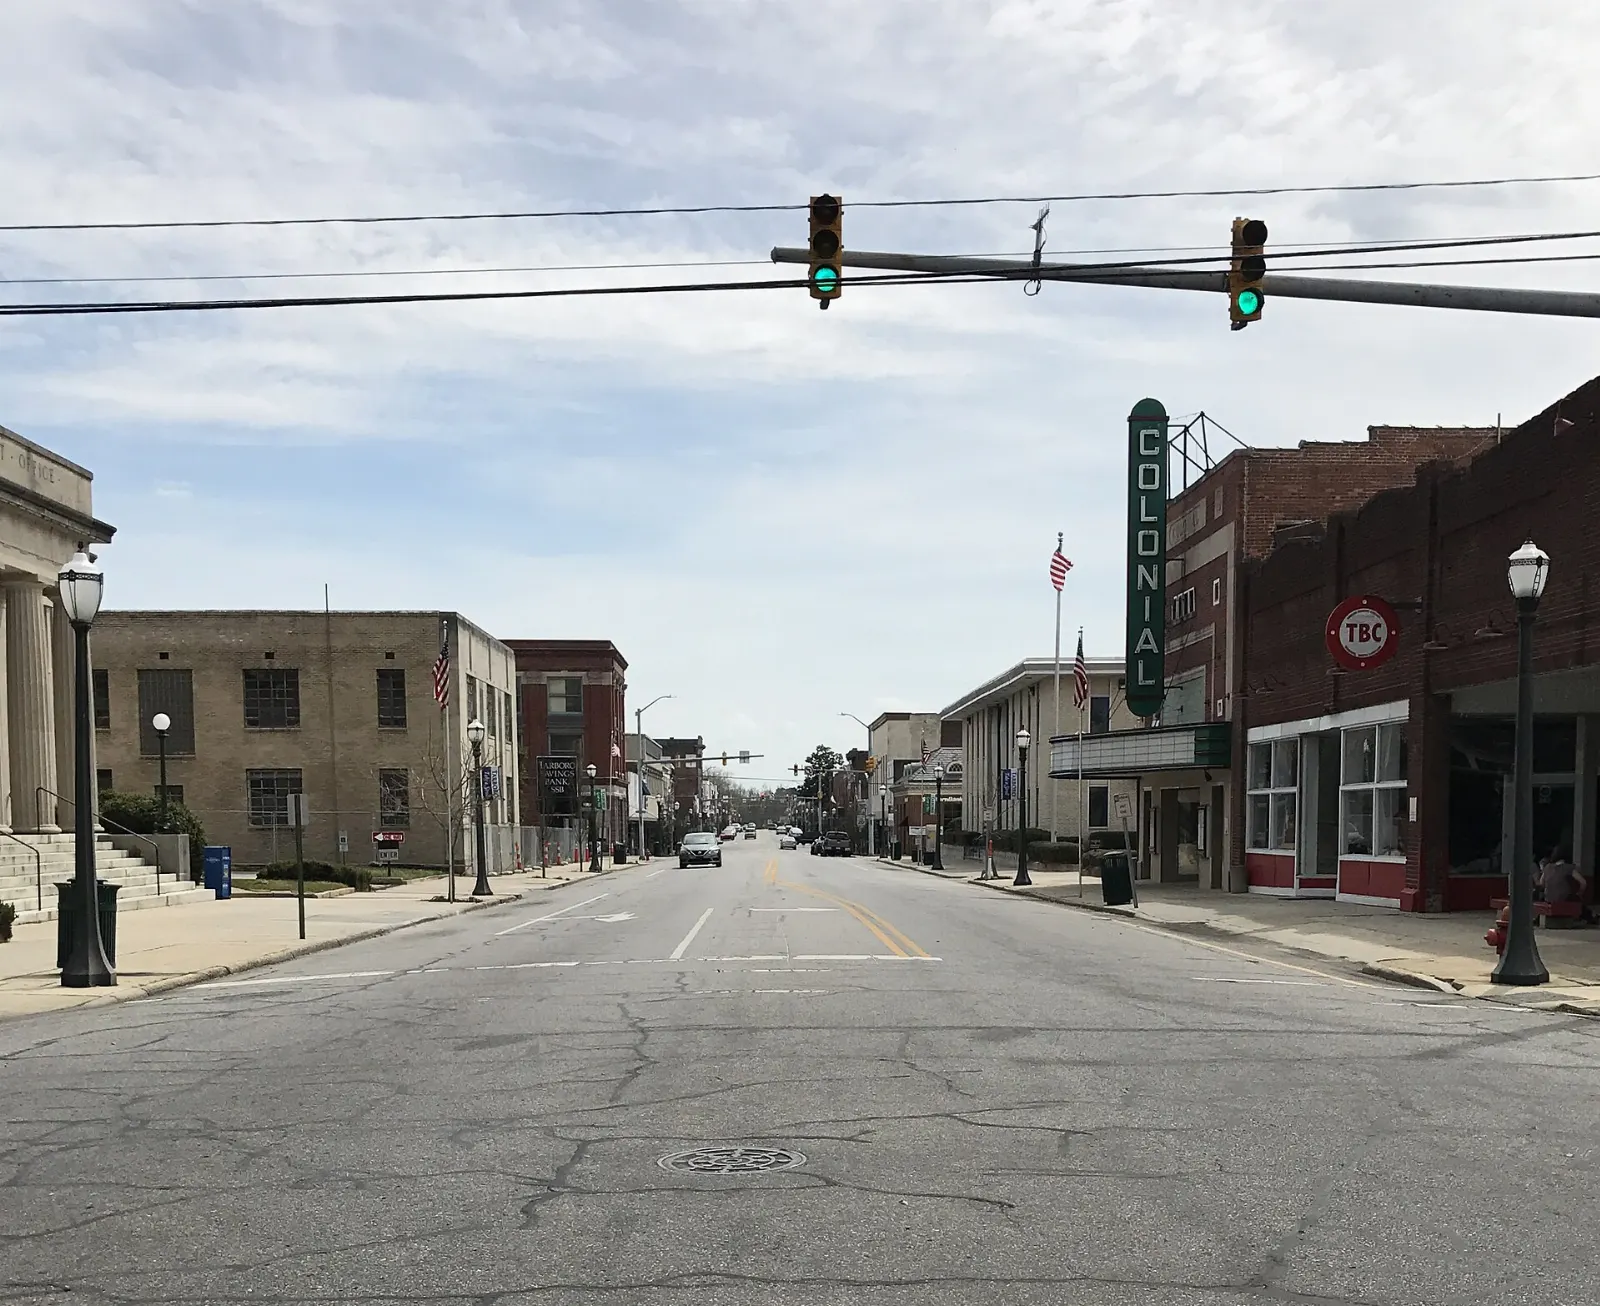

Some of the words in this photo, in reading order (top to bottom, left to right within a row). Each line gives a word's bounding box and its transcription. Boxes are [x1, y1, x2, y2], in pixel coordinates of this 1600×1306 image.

[18, 453, 55, 484] OFFICE
[1134, 428, 1160, 686] COLONIAL
[1345, 622, 1382, 644] TBC
